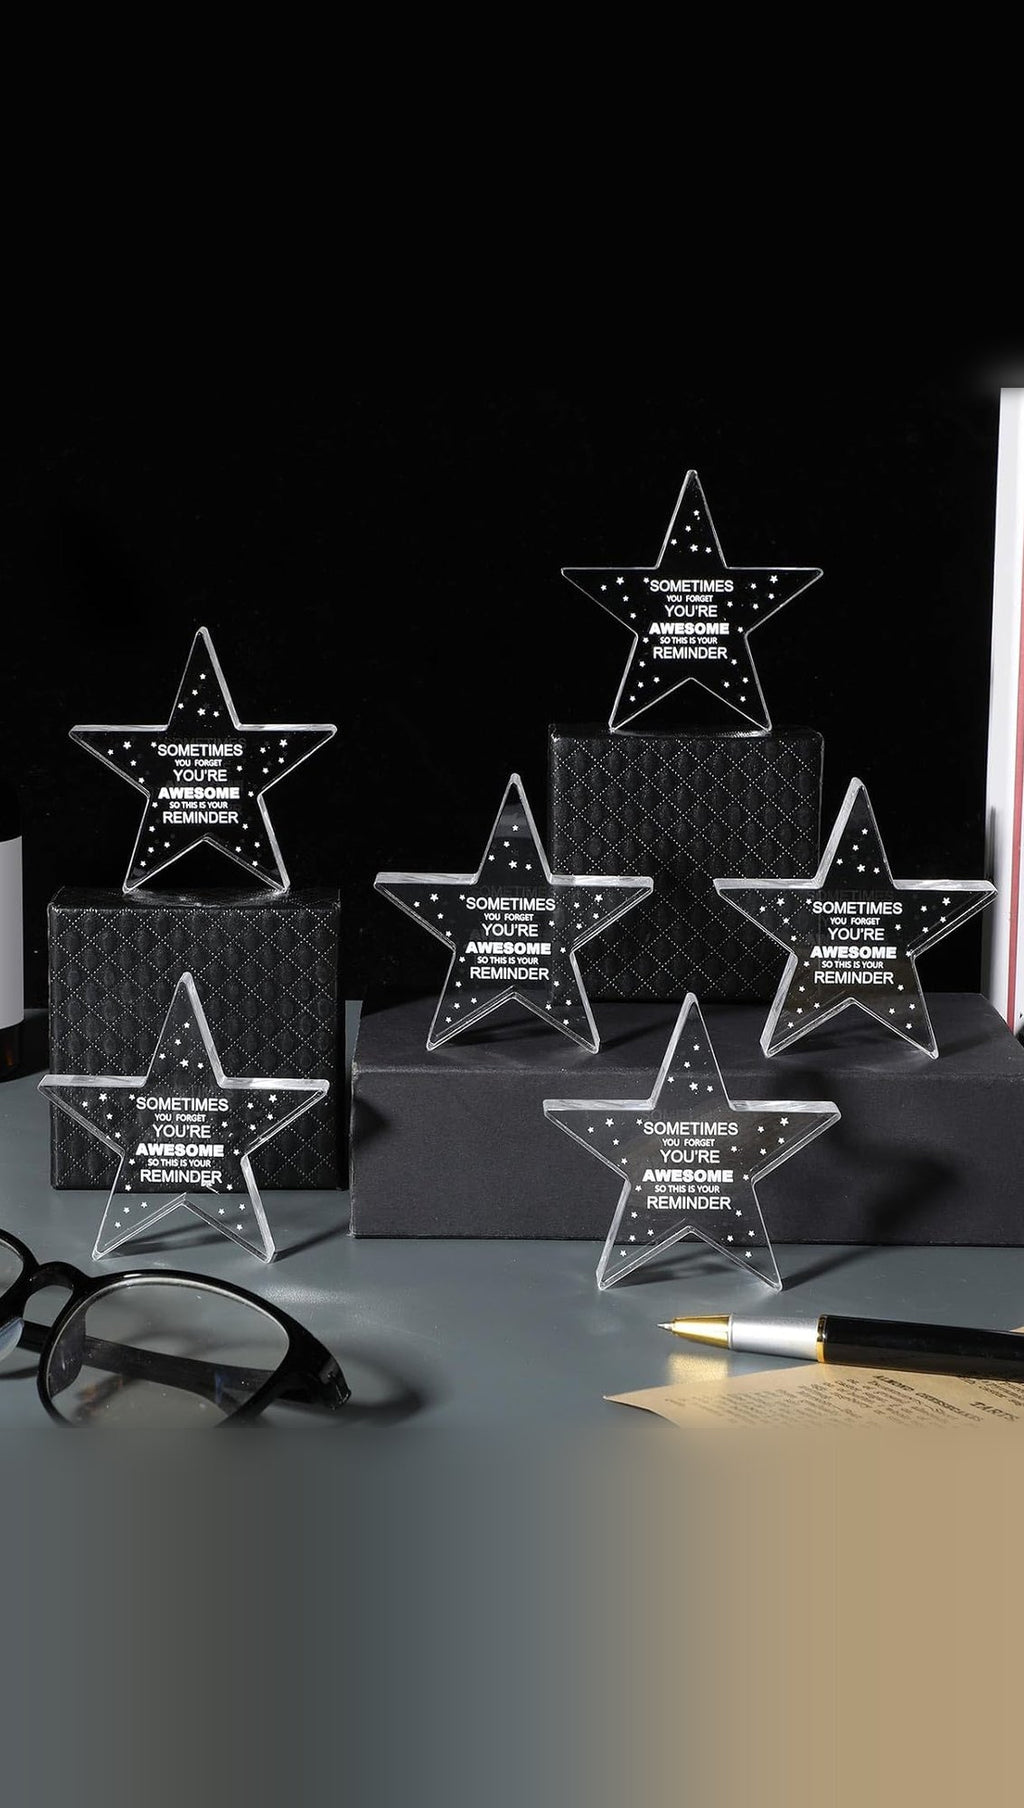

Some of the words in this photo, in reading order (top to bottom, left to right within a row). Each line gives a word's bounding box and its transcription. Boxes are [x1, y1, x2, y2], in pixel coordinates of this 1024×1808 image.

[650, 580, 734, 592] SOMETIMES
[664, 605, 718, 617] YOU'RE
[649, 622, 730, 635] AWESOME
[653, 647, 728, 659] REMINDER
[158, 743, 243, 757] SOMETIMES
[173, 769, 227, 781] YOU'RE
[158, 787, 240, 799] AWESOME
[163, 811, 239, 823] REMINDER
[466, 897, 556, 911] SOMETIMES
[812, 901, 903, 915] SOMETIMES
[484, 913, 500, 921] YOU
[504, 913, 534, 921] FORGET
[830, 917, 846, 925] YOU
[851, 917, 880, 925] FORGET
[482, 923, 538, 937] YOU'RE
[828, 928, 885, 941] YOU'RE
[465, 942, 552, 955] AWESOME
[810, 946, 897, 959] AWESOME
[477, 956, 488, 964] SO
[490, 956, 507, 964] THIS
[862, 961, 883, 969] YOUR
[470, 967, 549, 980] REMINDER
[814, 971, 894, 984] REMINDER
[136, 1097, 229, 1112] SOMETIMES
[155, 1113, 171, 1121] YOU
[176, 1114, 206, 1122] FORGET
[152, 1124, 211, 1138] YOU'RE
[643, 1121, 739, 1135] SOMETIMES
[662, 1138, 679, 1146] YOU
[136, 1143, 224, 1157] AWESOME
[660, 1149, 720, 1163] YOU'RE
[180, 1159, 187, 1167] IS
[189, 1159, 211, 1167] YOUR
[140, 1169, 222, 1184] REMINDER
[642, 1169, 733, 1182] AWESOME
[655, 1185, 666, 1193] SO
[668, 1185, 686, 1193] THIS
[688, 1185, 695, 1193] IS
[697, 1185, 720, 1193] YOUR
[647, 1196, 732, 1209] REMINDER
